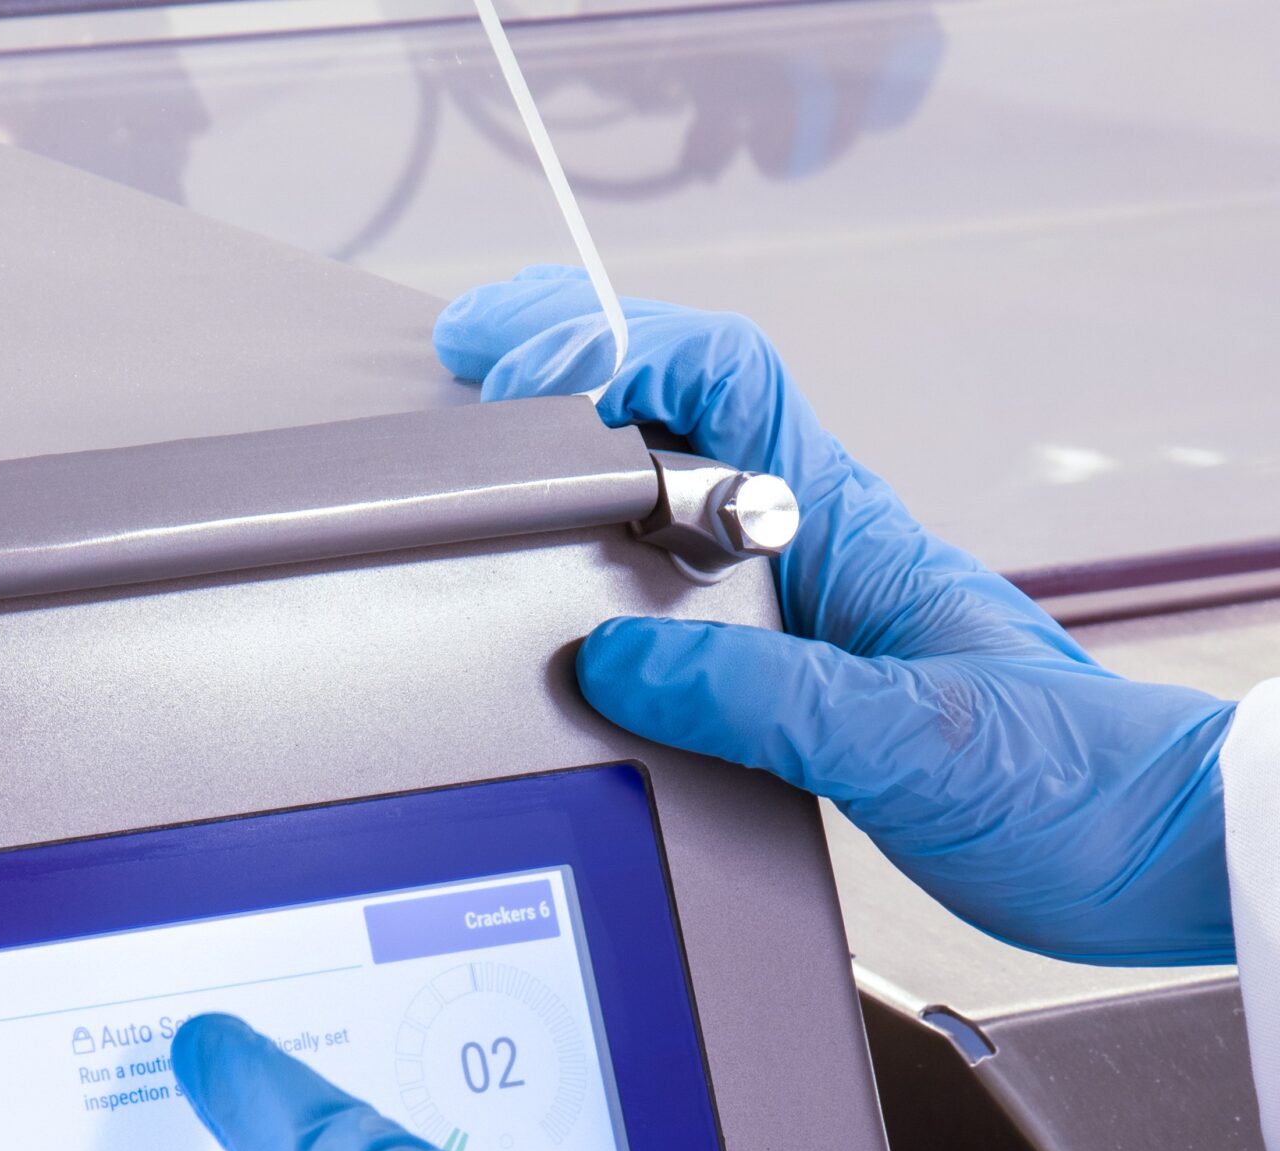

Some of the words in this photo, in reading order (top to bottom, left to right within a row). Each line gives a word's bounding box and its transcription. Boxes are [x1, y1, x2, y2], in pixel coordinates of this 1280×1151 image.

[464, 906, 536, 929] Crackers
[539, 900, 550, 918] 6
[101, 1023, 153, 1050] Auto
[324, 1028, 350, 1046] set
[79, 1063, 111, 1085] Run
[116, 1065, 125, 1079] a
[460, 1036, 525, 1094] 02
[83, 1083, 170, 1112] inspection
